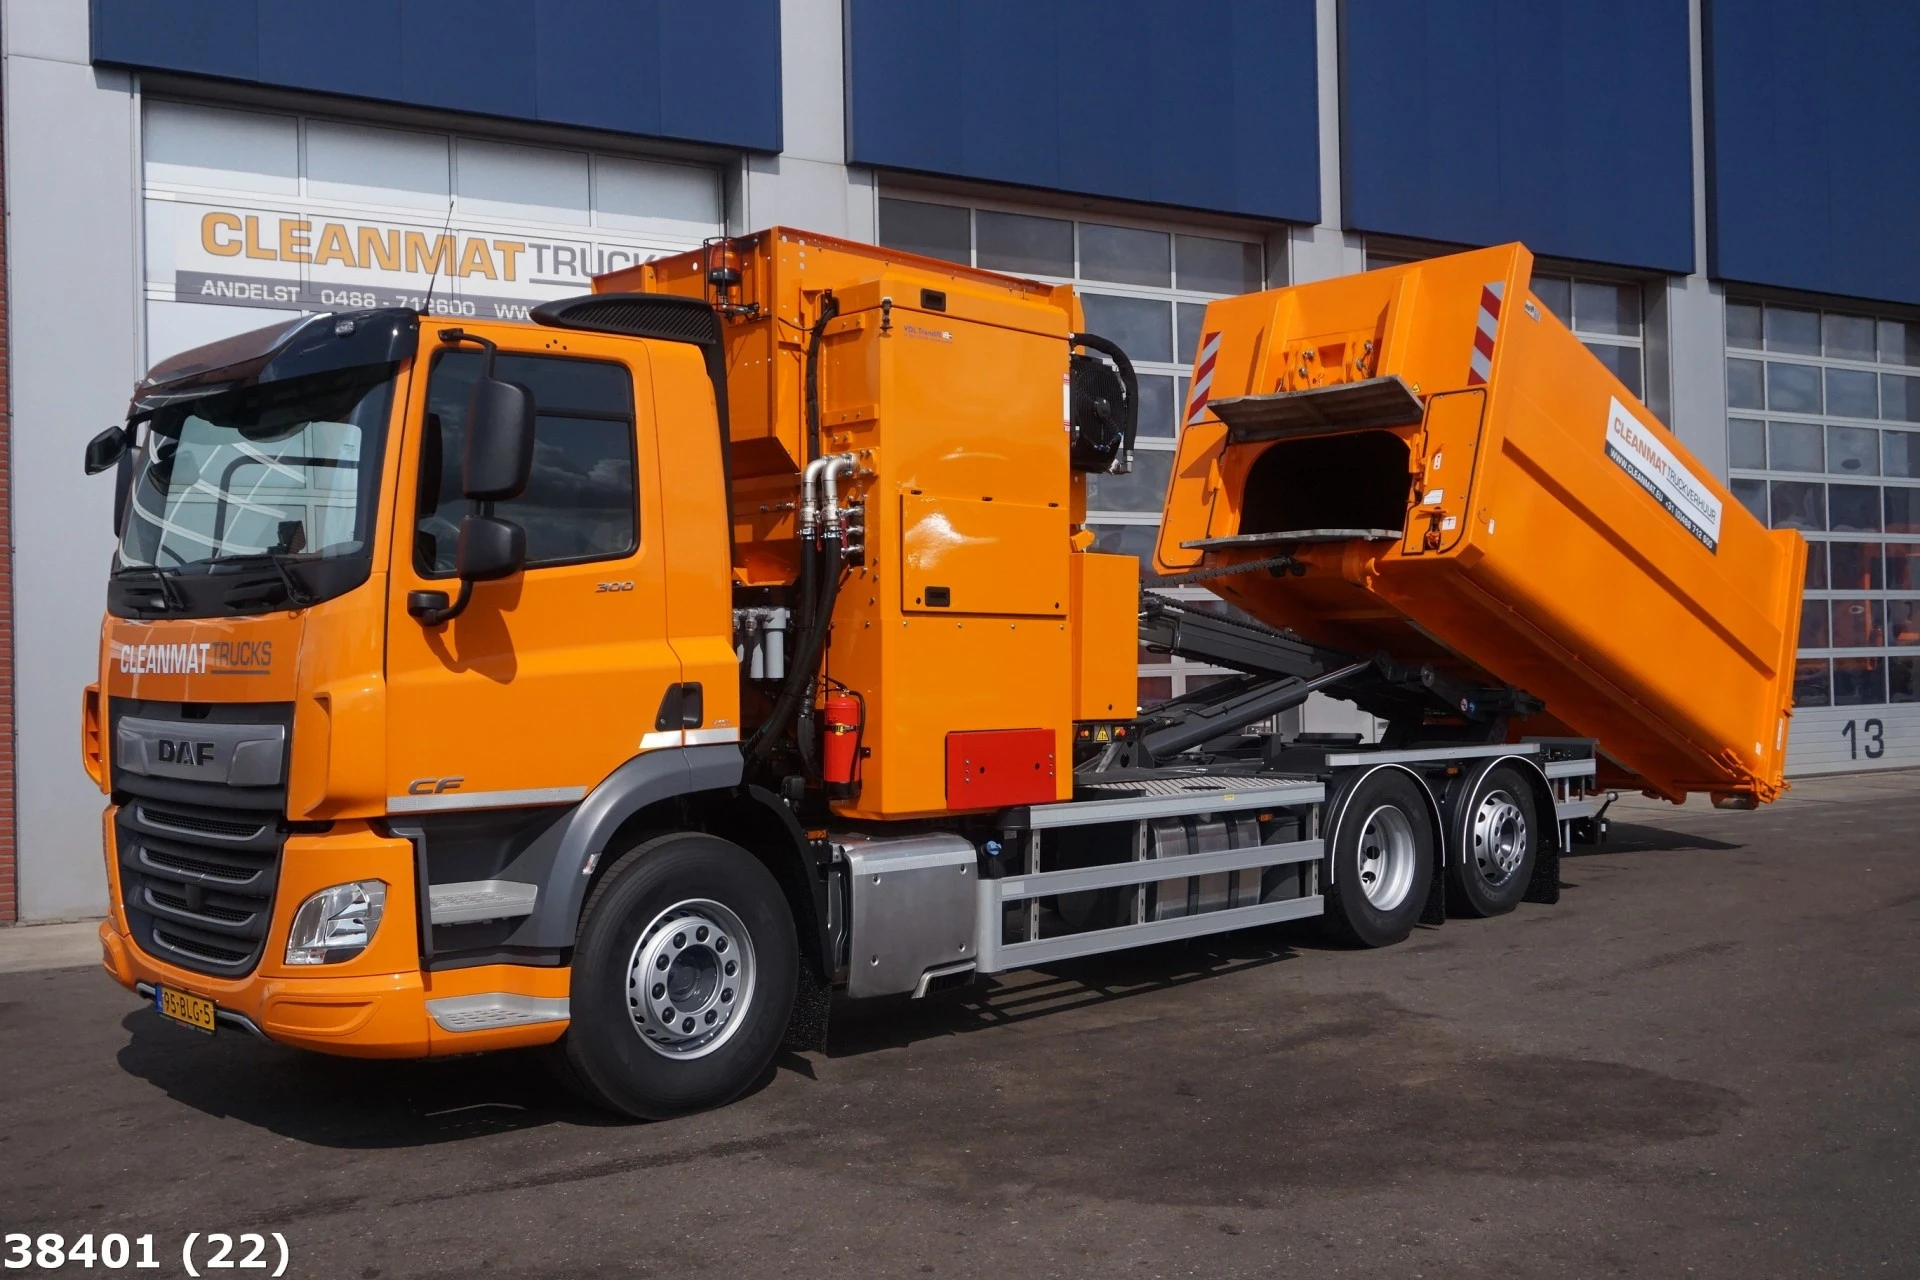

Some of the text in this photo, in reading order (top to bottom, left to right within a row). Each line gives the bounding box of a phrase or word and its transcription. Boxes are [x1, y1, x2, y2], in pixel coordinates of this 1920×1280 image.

[201, 212, 525, 282] CLEANMAT
[201, 279, 300, 303] ANDELST
[321, 289, 377, 308] 0488
[1614, 416, 1717, 522] CLEANMAT TRUCKVERHUUR
[1610, 447, 1664, 502] WWW.CLEANMAT.EU
[1692, 524, 1703, 540] 712
[594, 581, 635, 593] 300
[120, 641, 272, 674] CLEANMAT TRUCKS
[158, 739, 215, 767] DAF
[1842, 718, 1885, 760] 13
[407, 775, 465, 795] CF
[163, 991, 211, 1025] 95-BLG-5
